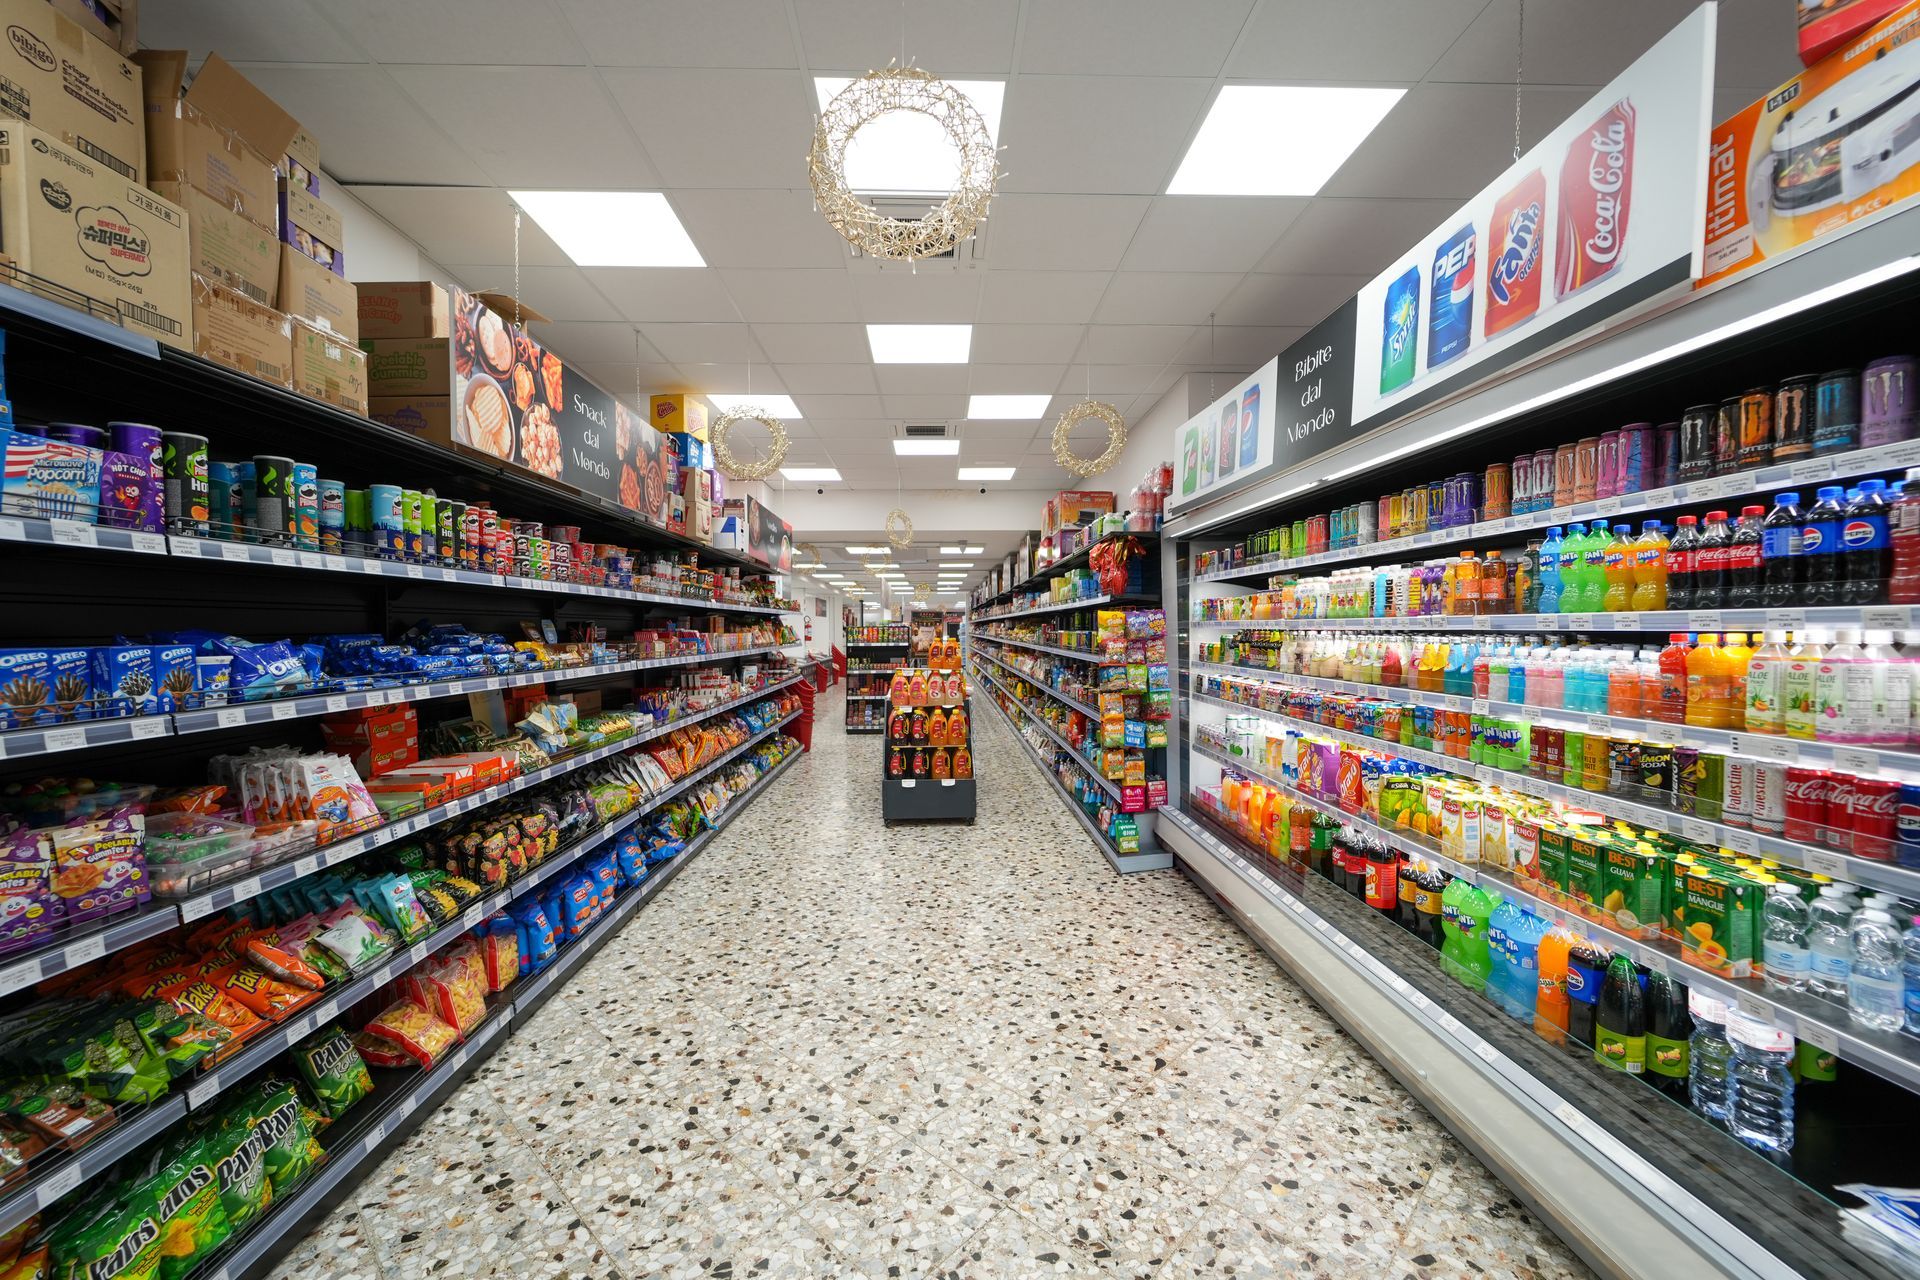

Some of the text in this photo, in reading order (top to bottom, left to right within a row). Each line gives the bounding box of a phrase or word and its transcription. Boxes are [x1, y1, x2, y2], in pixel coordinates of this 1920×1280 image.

[12, 29, 54, 65] bibigo
[62, 59, 90, 82] Crispy
[1586, 119, 1626, 264] Coca-Cola
[110, 247, 146, 264] SUPERMIX
[1433, 235, 1476, 289] PEP
[1488, 202, 1540, 305] Fanta
[1518, 229, 1543, 281] orange
[1392, 302, 1419, 363] Sprite
[369, 364, 428, 381] Gummies
[1295, 345, 1332, 382] Bibite
[1301, 378, 1322, 408] dal
[573, 393, 607, 430] Snack
[1287, 408, 1336, 447] Mondo
[583, 430, 600, 450] dal
[34, 457, 84, 470] Microwave
[129, 465, 147, 478] CHIP
[572, 448, 611, 480] Mondo
[27, 466, 86, 485] Popcorn
[1636, 549, 1659, 561] FANTA
[0, 651, 48, 668] OREO
[117, 648, 151, 663] OREO
[161, 646, 193, 661] OREO
[269, 659, 302, 679] ORE
[1639, 753, 1671, 764] LEMON
[1640, 760, 1667, 769] SODA
[1727, 763, 1742, 811] Palestine
[1755, 767, 1767, 817] Palestine
[1516, 826, 1536, 839] ENJOY
[1542, 831, 1565, 847] BEST
[1570, 838, 1597, 857] BEST
[1608, 850, 1637, 870] BEST
[1610, 866, 1635, 880] GUAVA
[1687, 877, 1725, 900] BEST
[1688, 893, 1725, 911] MANGUE
[226, 964, 265, 994] Tak
[177, 981, 217, 1014] Takis
[332, 1049, 360, 1079] Rolls
[159, 1163, 216, 1225] atos
